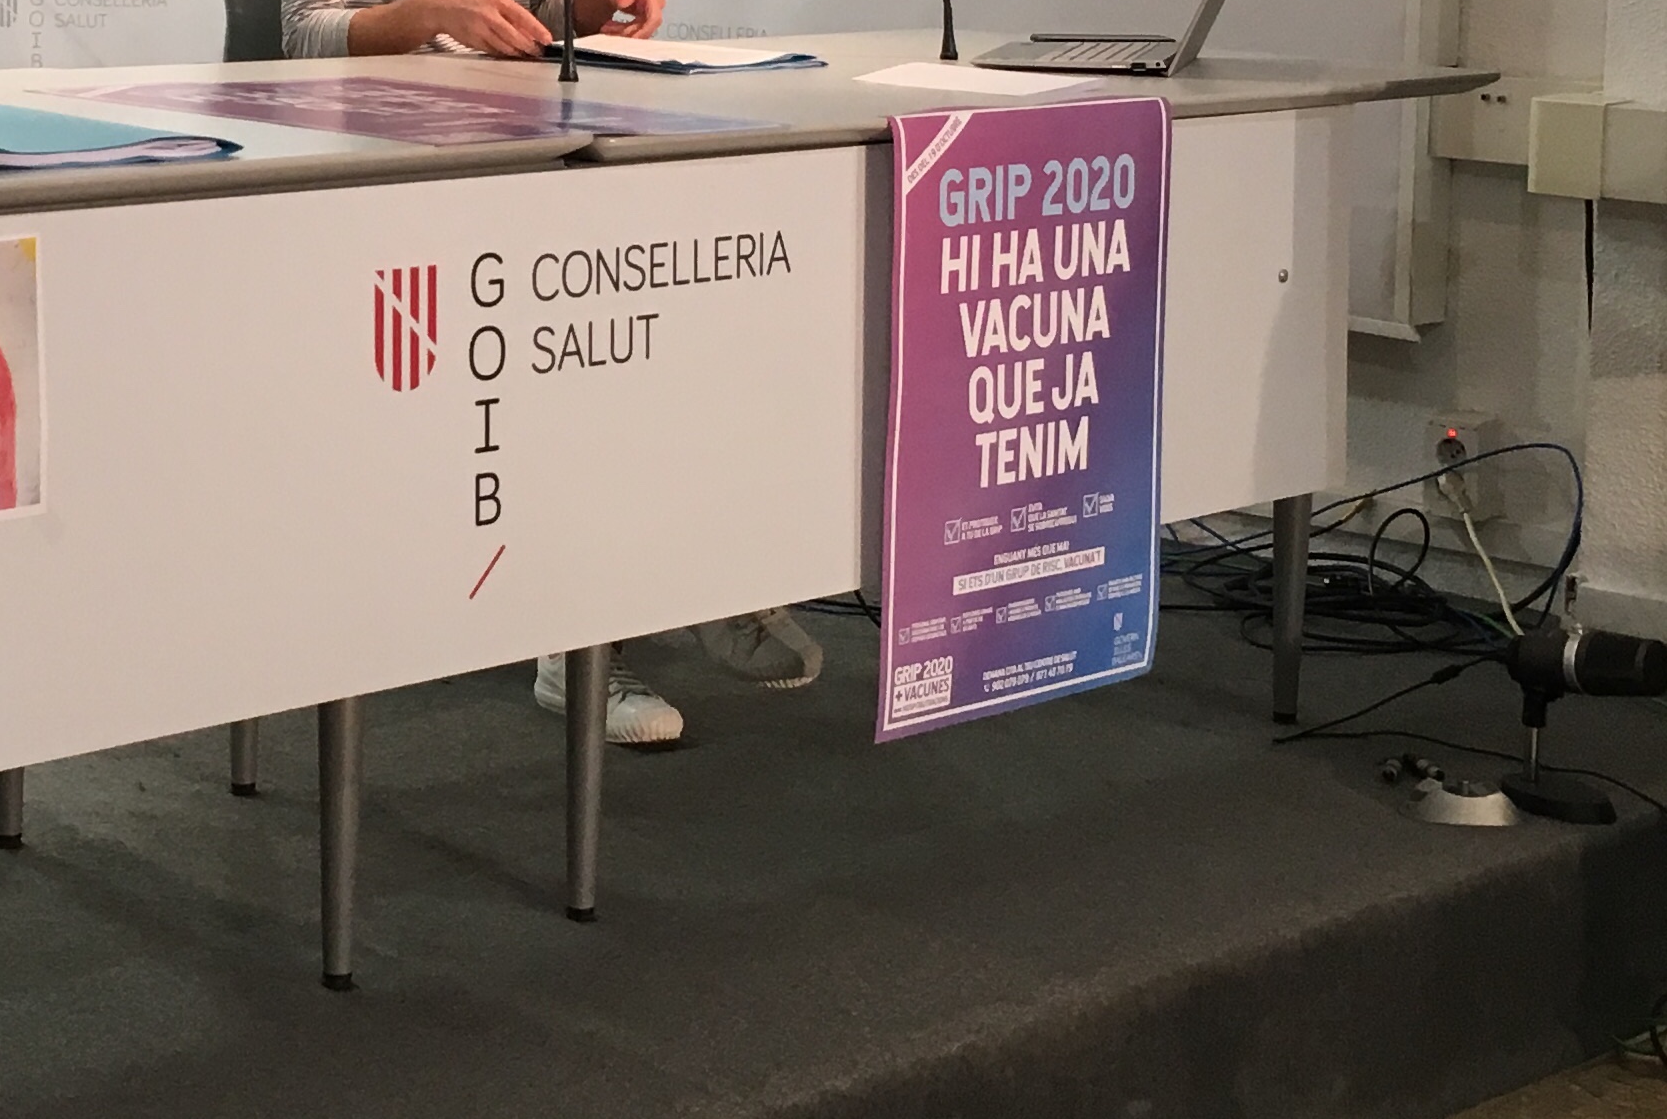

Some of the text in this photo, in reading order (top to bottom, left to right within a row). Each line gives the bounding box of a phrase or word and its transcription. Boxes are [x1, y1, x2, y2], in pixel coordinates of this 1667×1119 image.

[53, 13, 108, 29] SALUT
[939, 153, 1135, 228] GRIP 2020
[531, 230, 792, 302] CONSELLERIA
[940, 219, 1131, 295] HI HA UNA
[531, 313, 660, 374] SALUT
[959, 285, 1111, 358] VACUNA
[968, 351, 1099, 424] QUE JA
[975, 416, 1090, 489] TENIM
[968, 574, 983, 589] ETS
[1005, 566, 1029, 582] GRUP
[1030, 563, 1042, 576] DE
[894, 655, 953, 685] GRIP 2020
[904, 678, 950, 701] VACUNES
